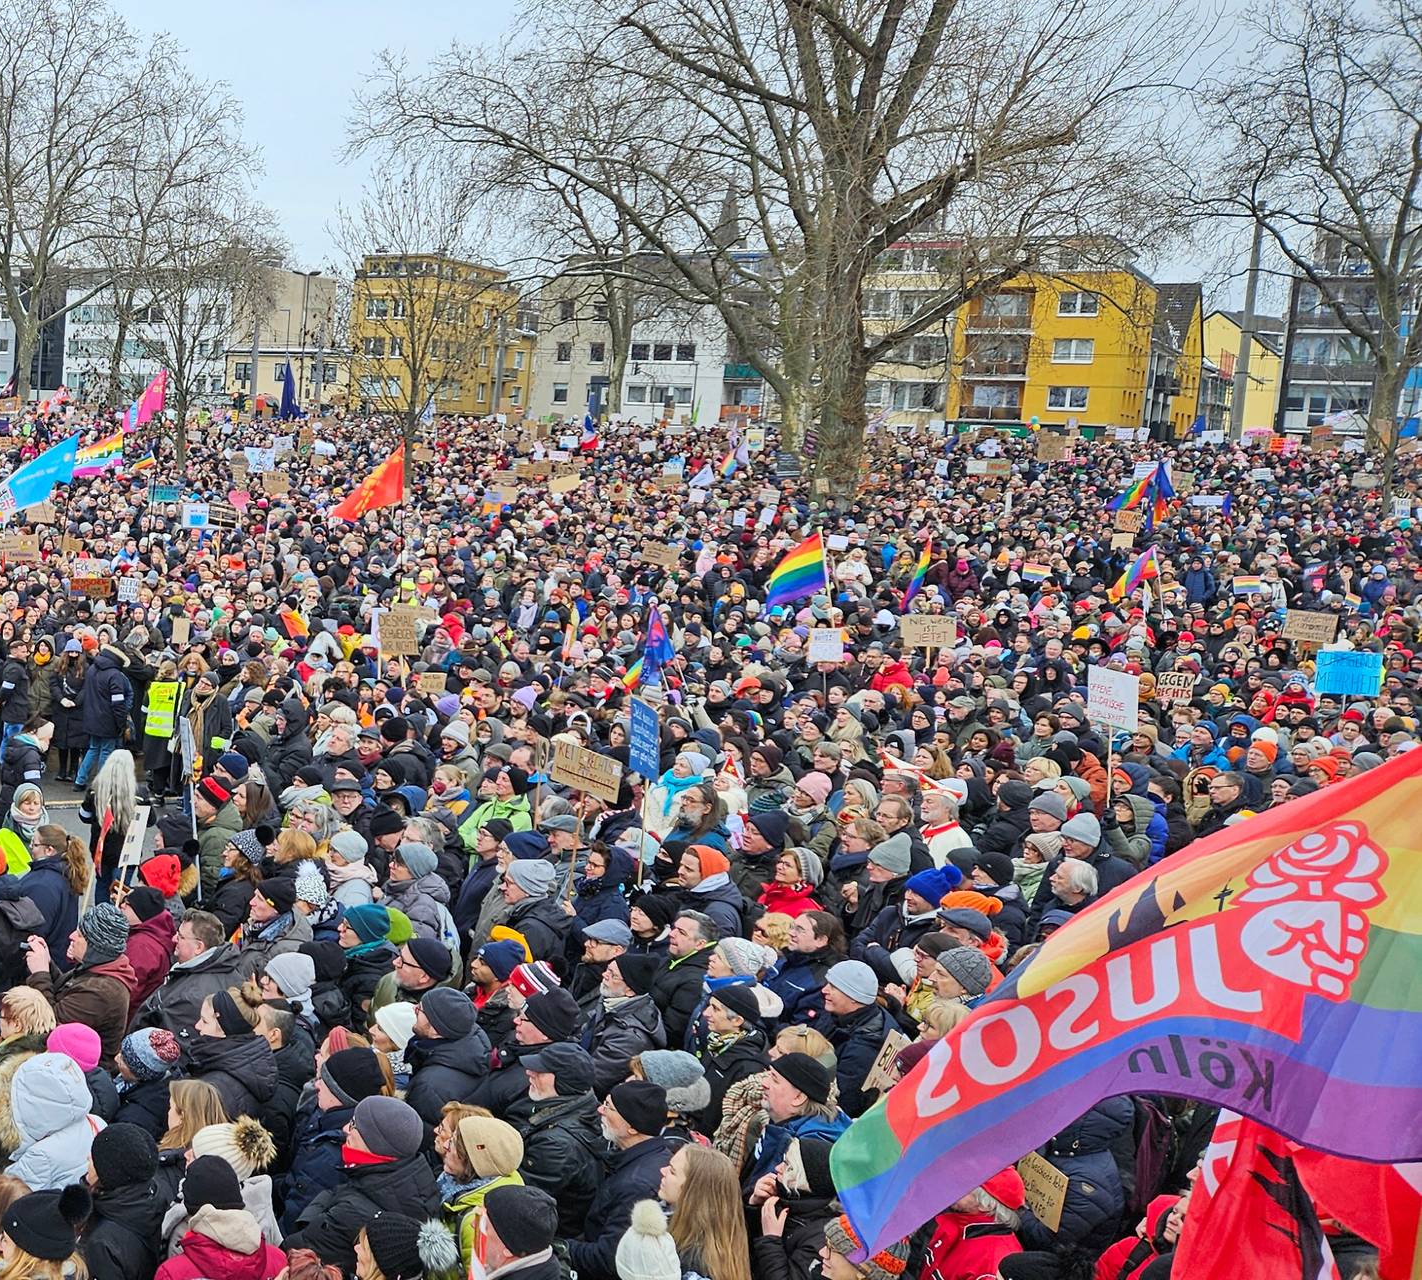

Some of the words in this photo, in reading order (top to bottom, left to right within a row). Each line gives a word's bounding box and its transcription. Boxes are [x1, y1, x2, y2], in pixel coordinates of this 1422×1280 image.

[914, 632, 947, 643] JETZT
[1159, 673, 1194, 688] GEGEN
[1316, 671, 1380, 695] MEHRHEIT
[1156, 687, 1191, 699] RECHTS
